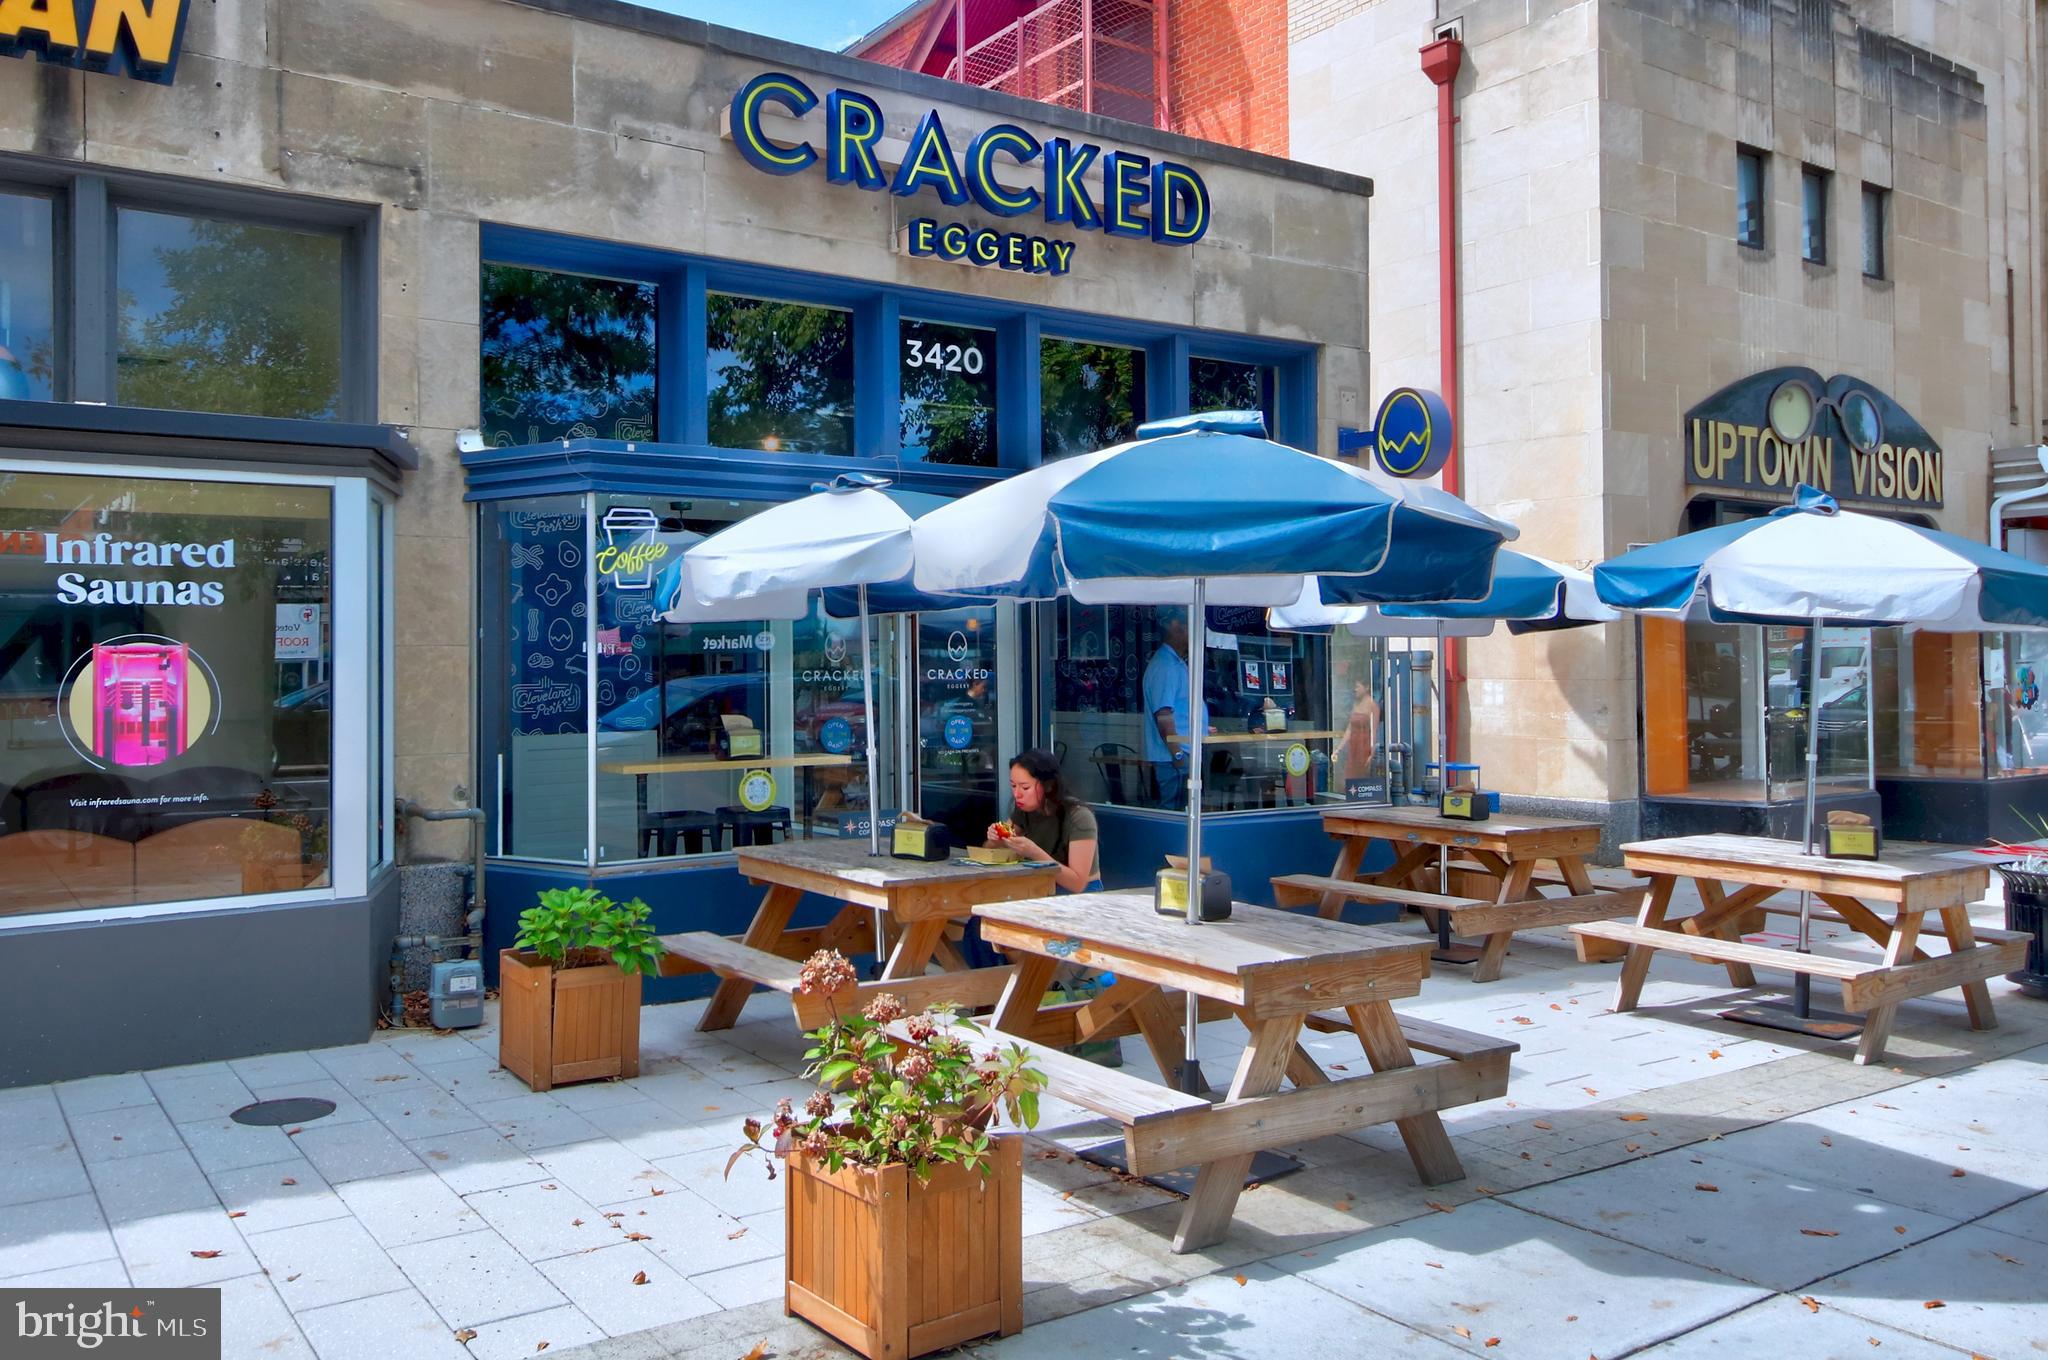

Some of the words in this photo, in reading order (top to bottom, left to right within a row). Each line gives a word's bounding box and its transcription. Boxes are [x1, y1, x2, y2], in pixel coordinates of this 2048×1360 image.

[730, 72, 1211, 247] CRACKED
[908, 217, 1076, 277] EGGERY
[906, 340, 984, 375] 3420
[1693, 418, 1832, 492] UPTOWN
[1851, 442, 1942, 503] VISION
[44, 532, 236, 568] Infrared
[596, 541, 668, 575] Coffee
[57, 573, 225, 606] Saunas
[927, 668, 989, 680] CRACKED
[517, 683, 573, 708] Cleveland
[69, 798, 88, 807] Visit
[88, 797, 159, 808] infraredsauna.com
[159, 794, 171, 805] for
[192, 792, 209, 803] info.
[1357, 785, 1383, 793] COMPASS
